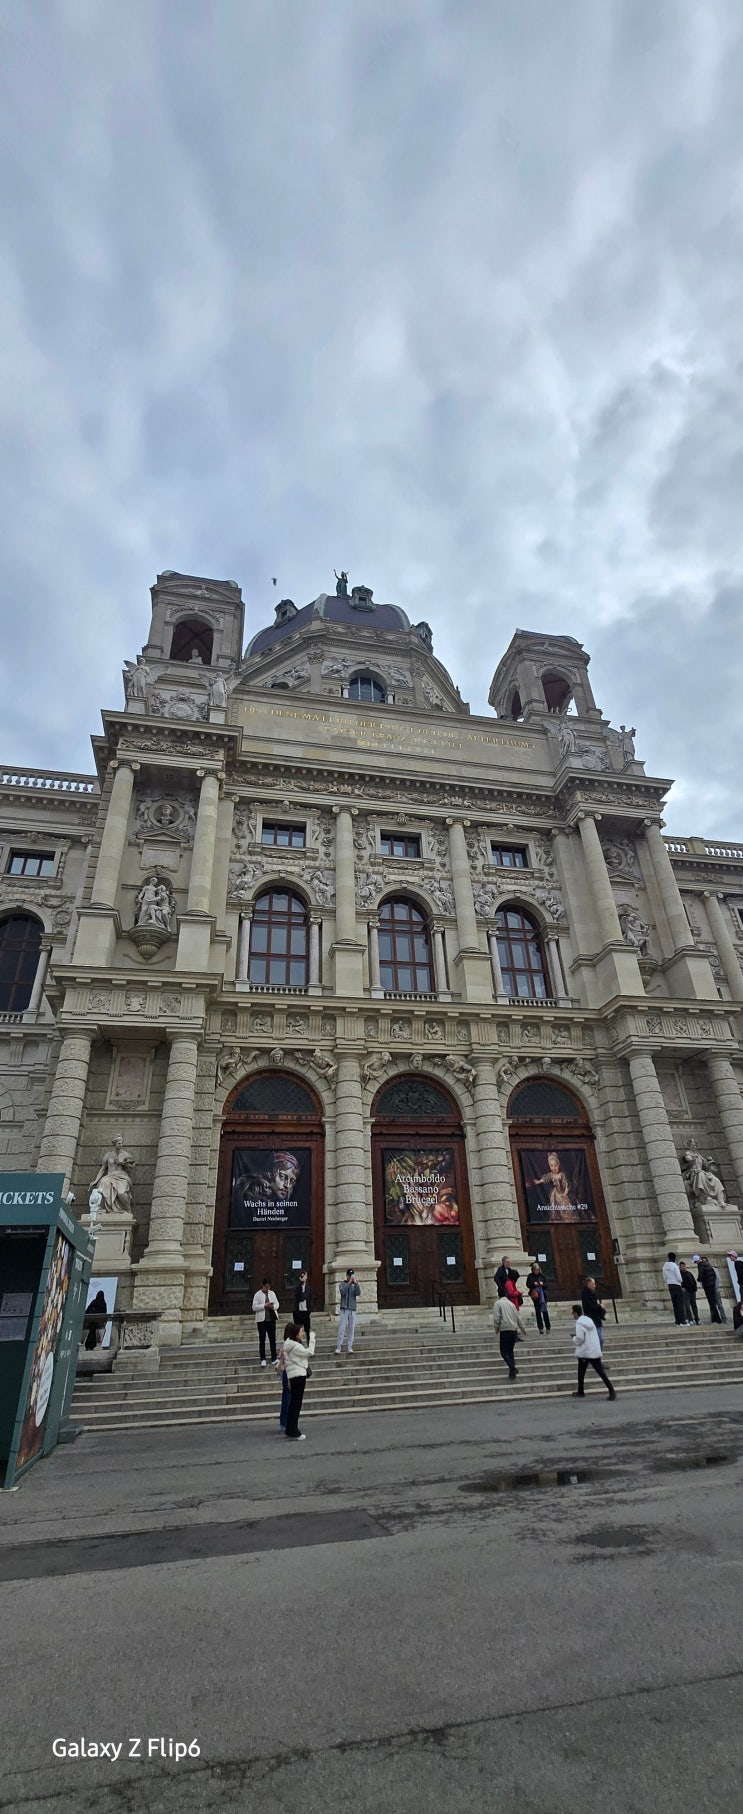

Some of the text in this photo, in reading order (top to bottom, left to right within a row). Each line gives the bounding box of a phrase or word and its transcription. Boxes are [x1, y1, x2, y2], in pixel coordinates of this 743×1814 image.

[394, 1173, 446, 1183] Arcimboldo
[403, 1184, 439, 1194] Bassano
[244, 1200, 266, 1208] Wachs
[405, 1195, 438, 1206] Bruegel
